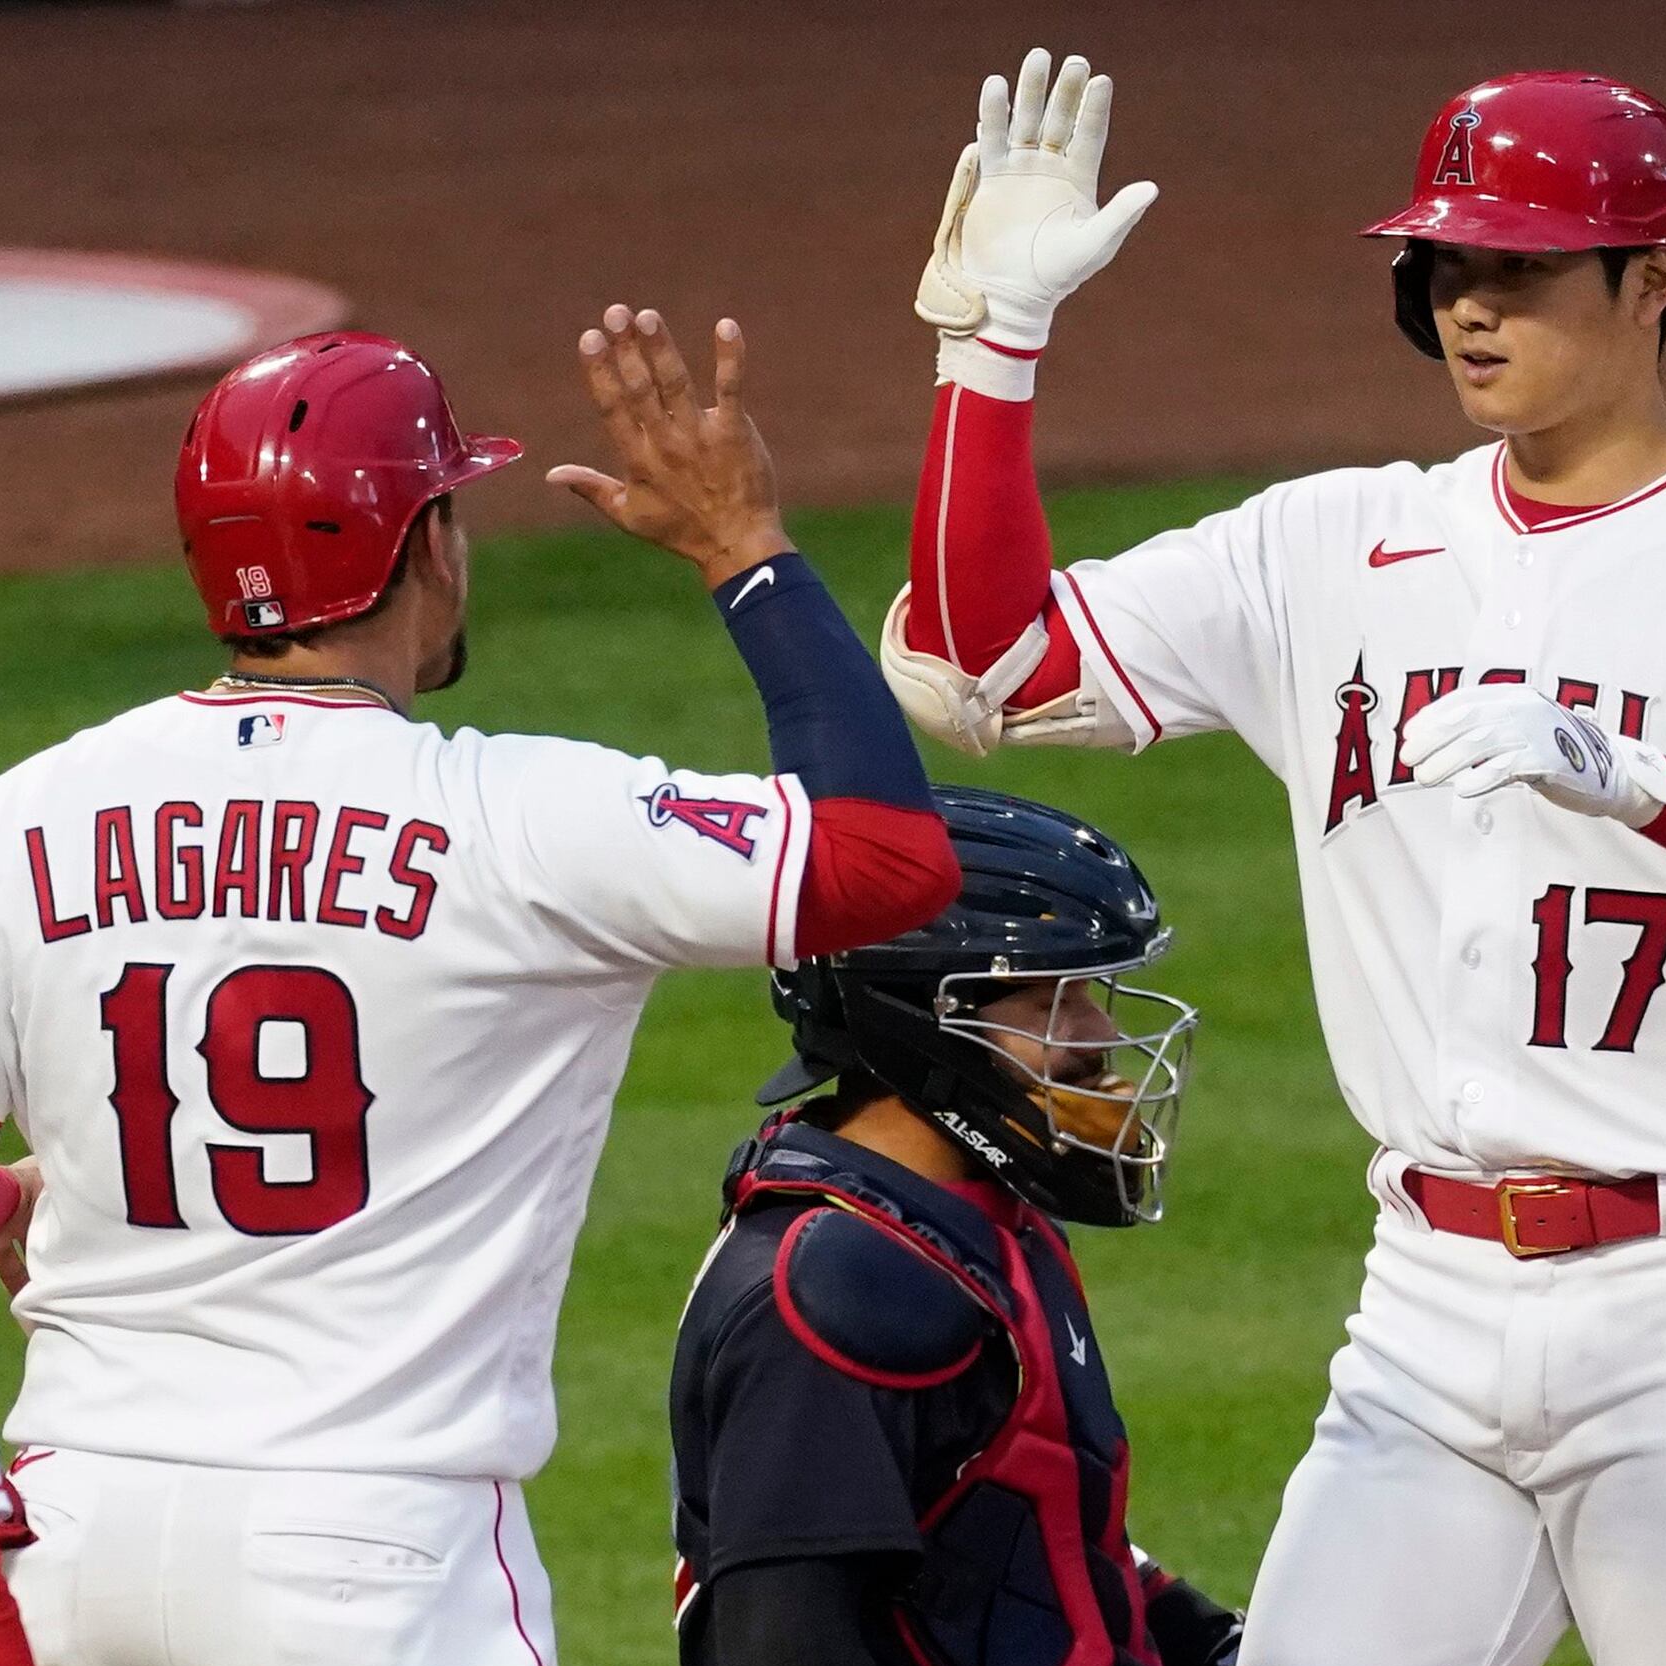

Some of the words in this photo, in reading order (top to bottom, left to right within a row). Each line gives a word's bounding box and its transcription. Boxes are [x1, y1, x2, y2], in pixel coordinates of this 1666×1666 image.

[236, 566, 271, 599] 19
[25, 800, 450, 943] LAGARES
[100, 962, 376, 1236] 19
